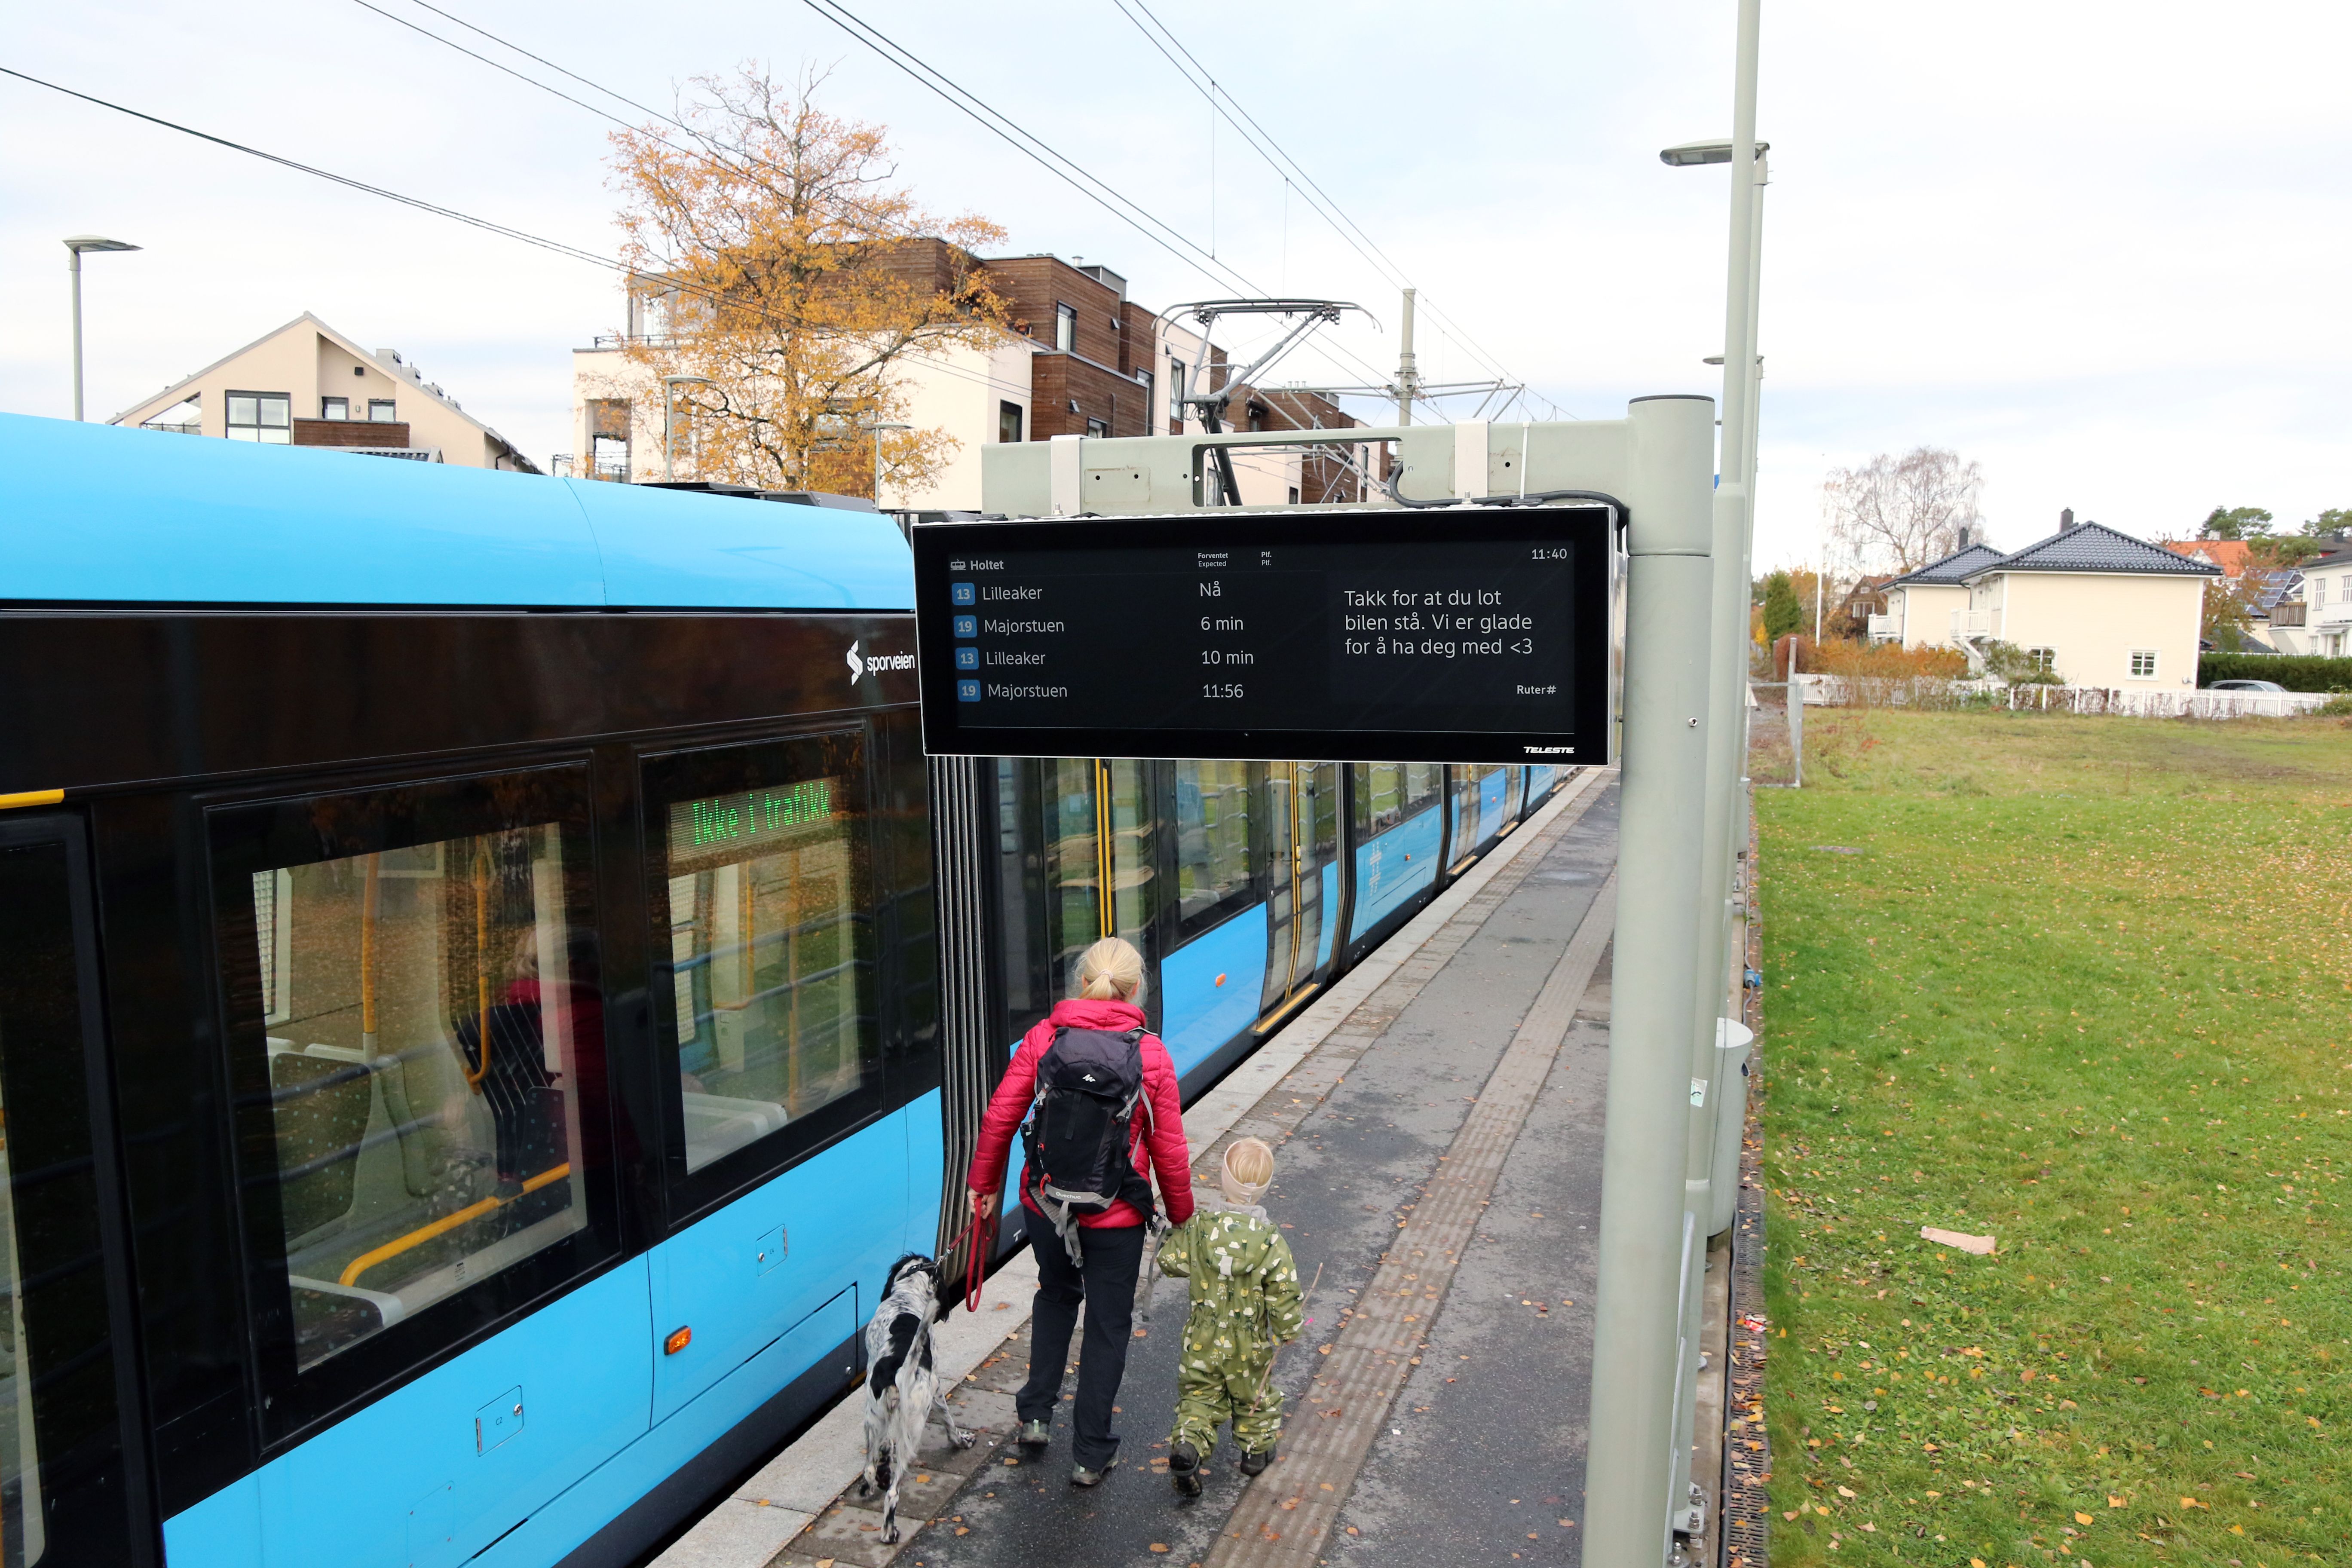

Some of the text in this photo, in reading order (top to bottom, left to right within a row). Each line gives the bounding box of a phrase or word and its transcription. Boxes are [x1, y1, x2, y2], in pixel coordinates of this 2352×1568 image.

[1532, 548, 1567, 559] 11:40
[970, 560, 1004, 570] Holtet
[957, 586, 1043, 600] 13 Lilleaker
[1200, 580, 1221, 597] Nå
[1344, 589, 1501, 606] Takk for at du lot
[958, 619, 1064, 636] 19 Majorstuen
[1201, 616, 1243, 631] 6 min
[1345, 612, 1532, 634] bilen stå. Vi er glade
[1345, 636, 1532, 658] for å ha deg med <3
[867, 650, 915, 677] sporveien
[960, 651, 1046, 665] 13 Lilleaker
[1202, 650, 1253, 664] 10 min
[962, 684, 1067, 701] 19 Majorstuen
[1203, 684, 1243, 698] 11:56
[1517, 685, 1557, 694] Ruter#
[692, 781, 830, 845] Ikke i trafikk
